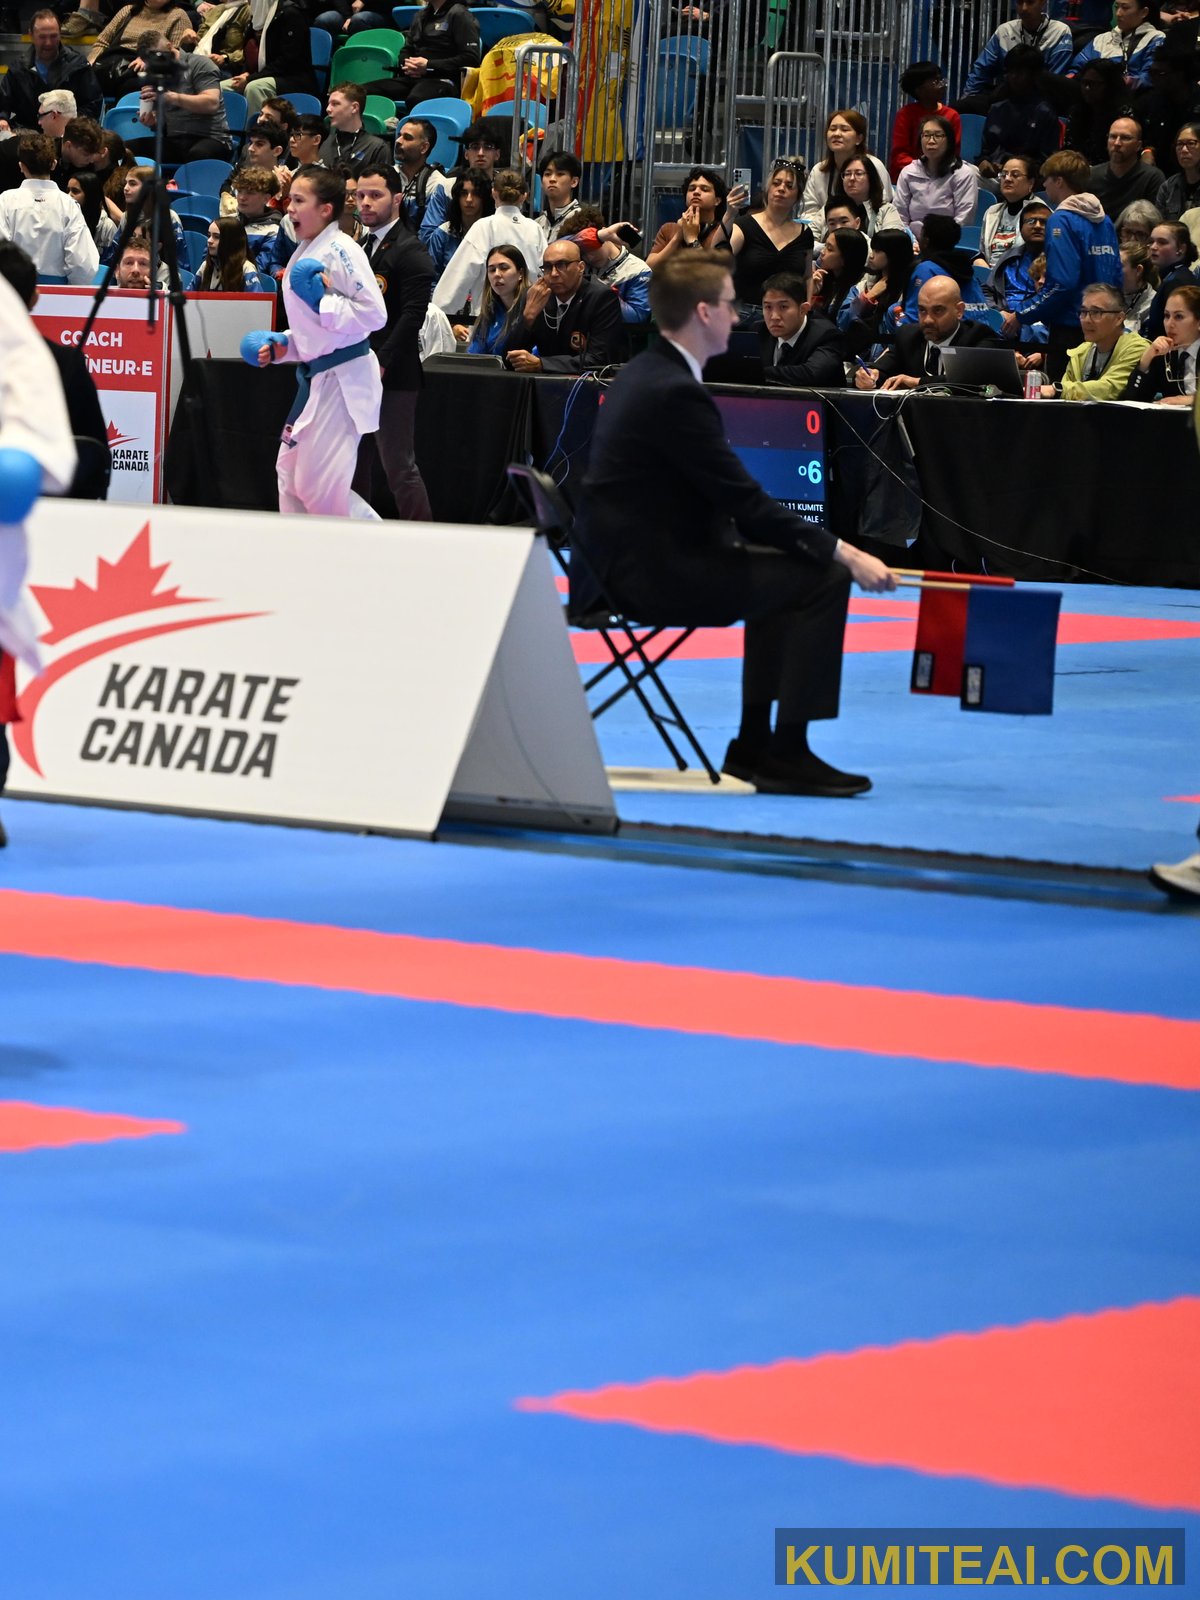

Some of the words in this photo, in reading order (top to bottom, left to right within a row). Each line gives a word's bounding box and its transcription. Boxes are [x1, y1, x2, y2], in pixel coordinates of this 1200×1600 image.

[60, 330, 123, 347] COACH
[806, 410, 821, 434] 0
[112, 449, 149, 460] KARATE
[112, 460, 149, 471] CANADA
[797, 503, 824, 512] KUMITE
[97, 663, 300, 723] KARATE
[80, 717, 278, 778] CANADA
